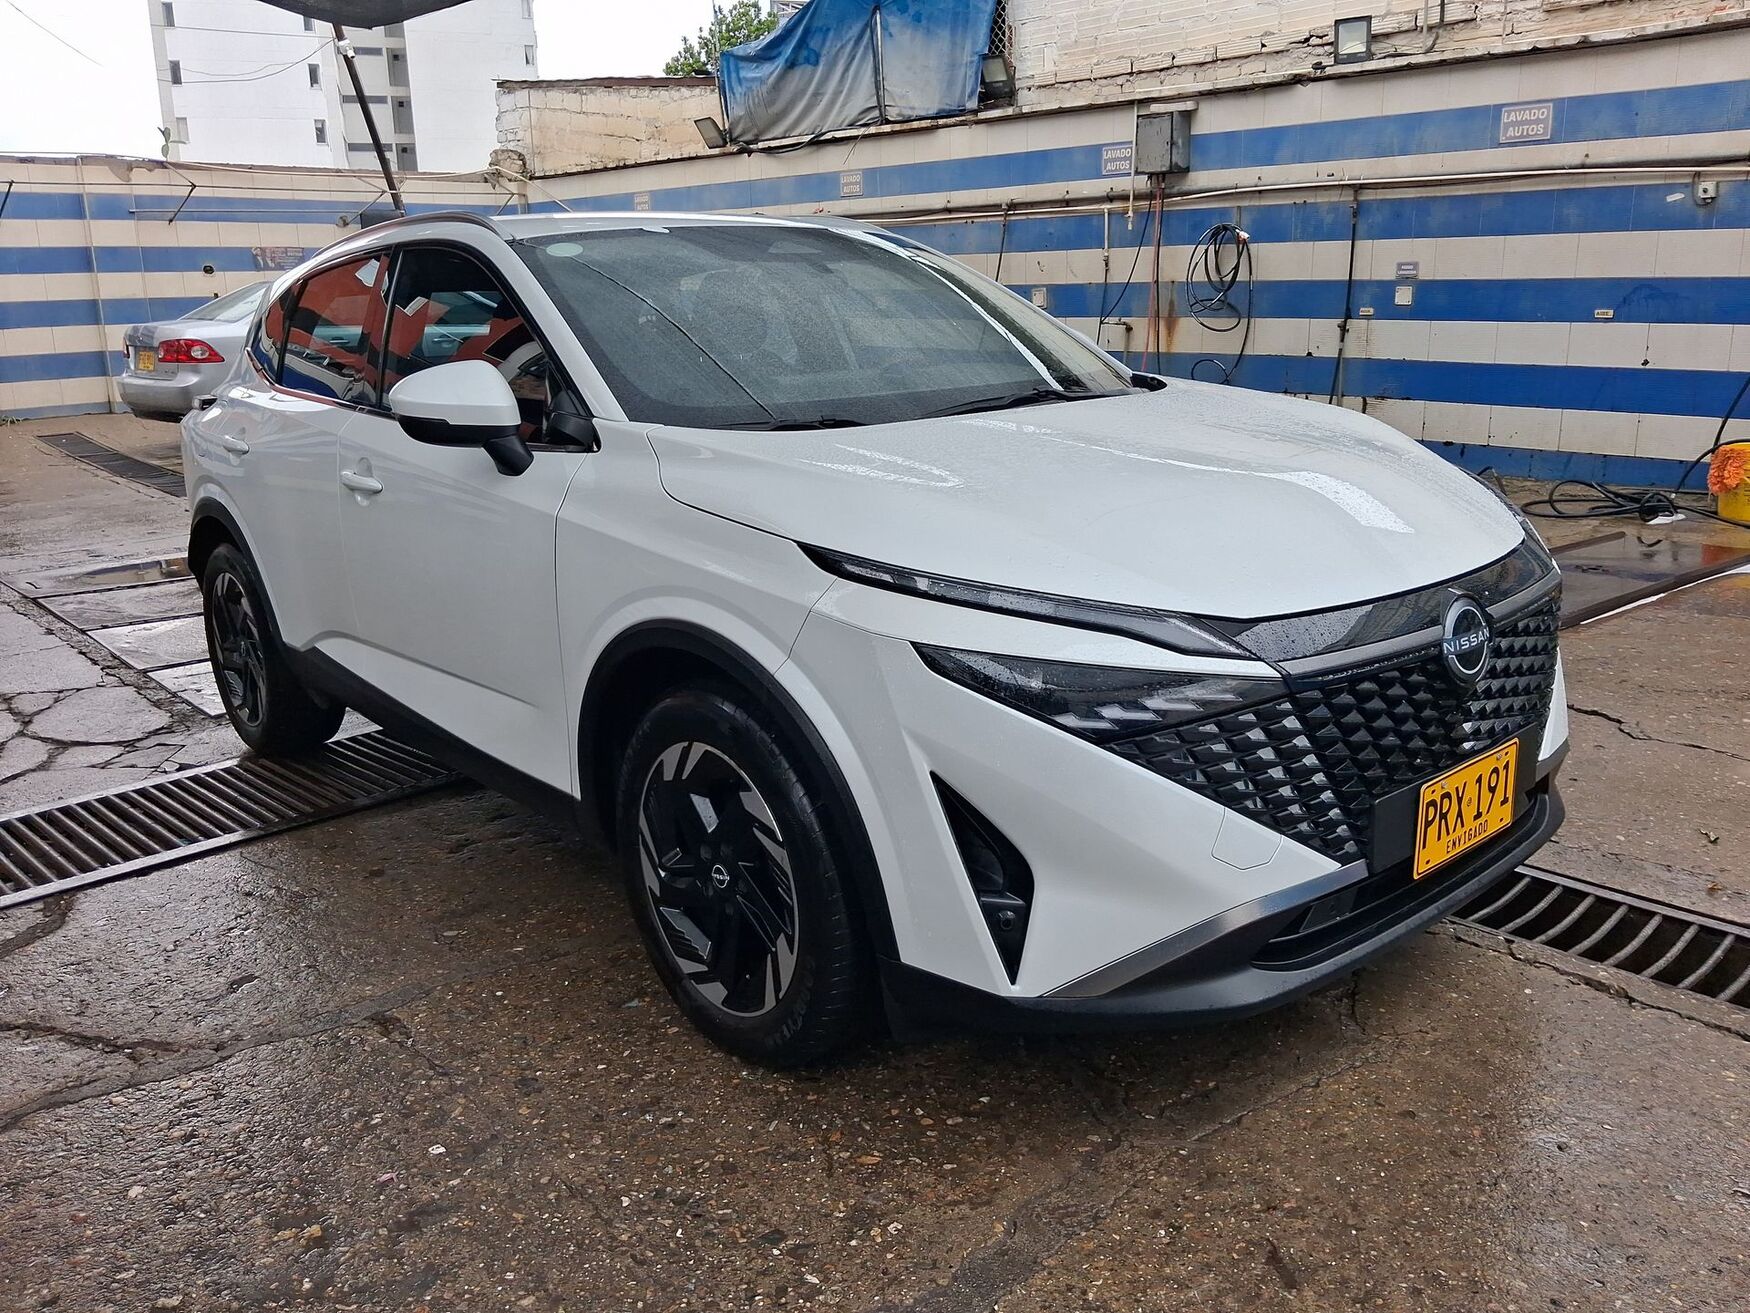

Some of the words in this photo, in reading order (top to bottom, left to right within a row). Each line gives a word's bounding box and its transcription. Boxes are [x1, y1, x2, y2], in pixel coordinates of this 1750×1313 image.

[1503, 108, 1548, 122] LAVADO
[1506, 124, 1544, 137] AUTOS
[1104, 148, 1131, 159] LAVADO
[1106, 160, 1130, 171] AUTOS
[1443, 626, 1490, 654] NISSAN
[1422, 781, 1467, 850] PRX
[1473, 760, 1510, 822] 191
[1446, 819, 1489, 854] ENVIGADO
